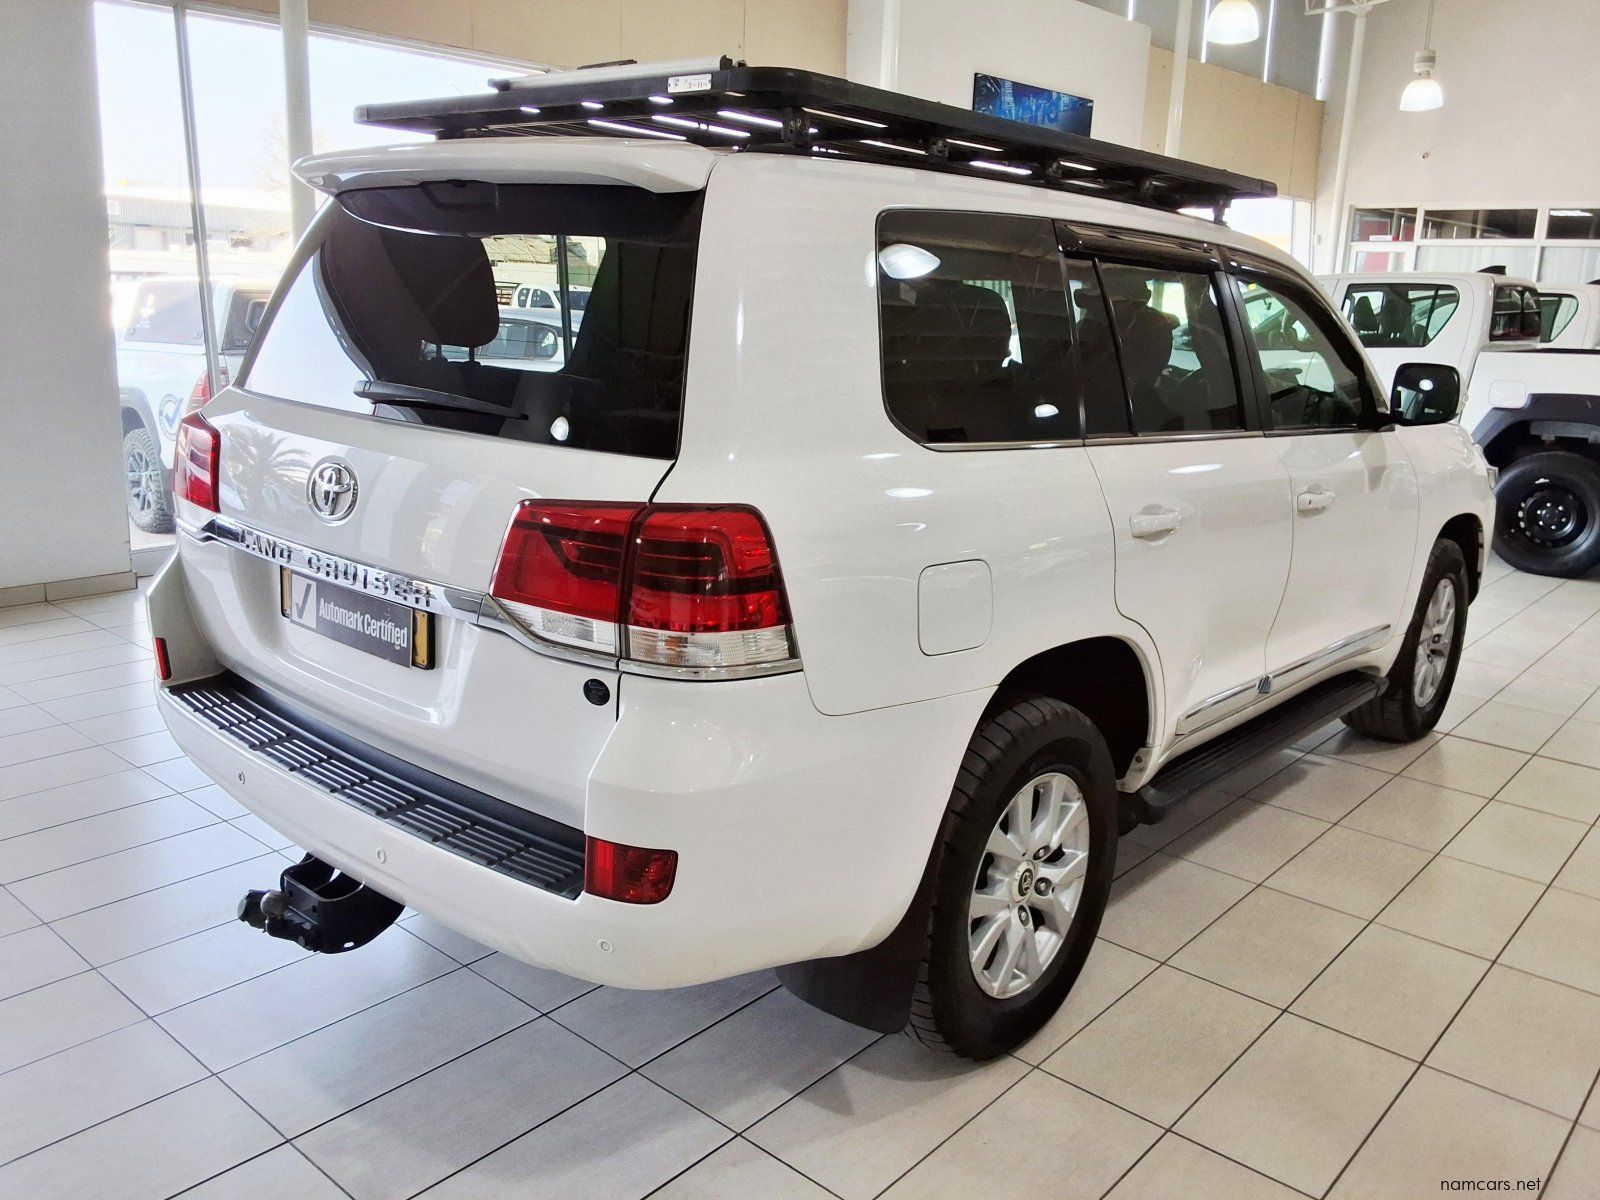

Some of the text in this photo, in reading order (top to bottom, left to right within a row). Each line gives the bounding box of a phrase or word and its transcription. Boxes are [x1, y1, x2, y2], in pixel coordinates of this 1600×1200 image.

[238, 526, 432, 608] LAND CRUISER
[319, 598, 408, 650] Automark Certified
